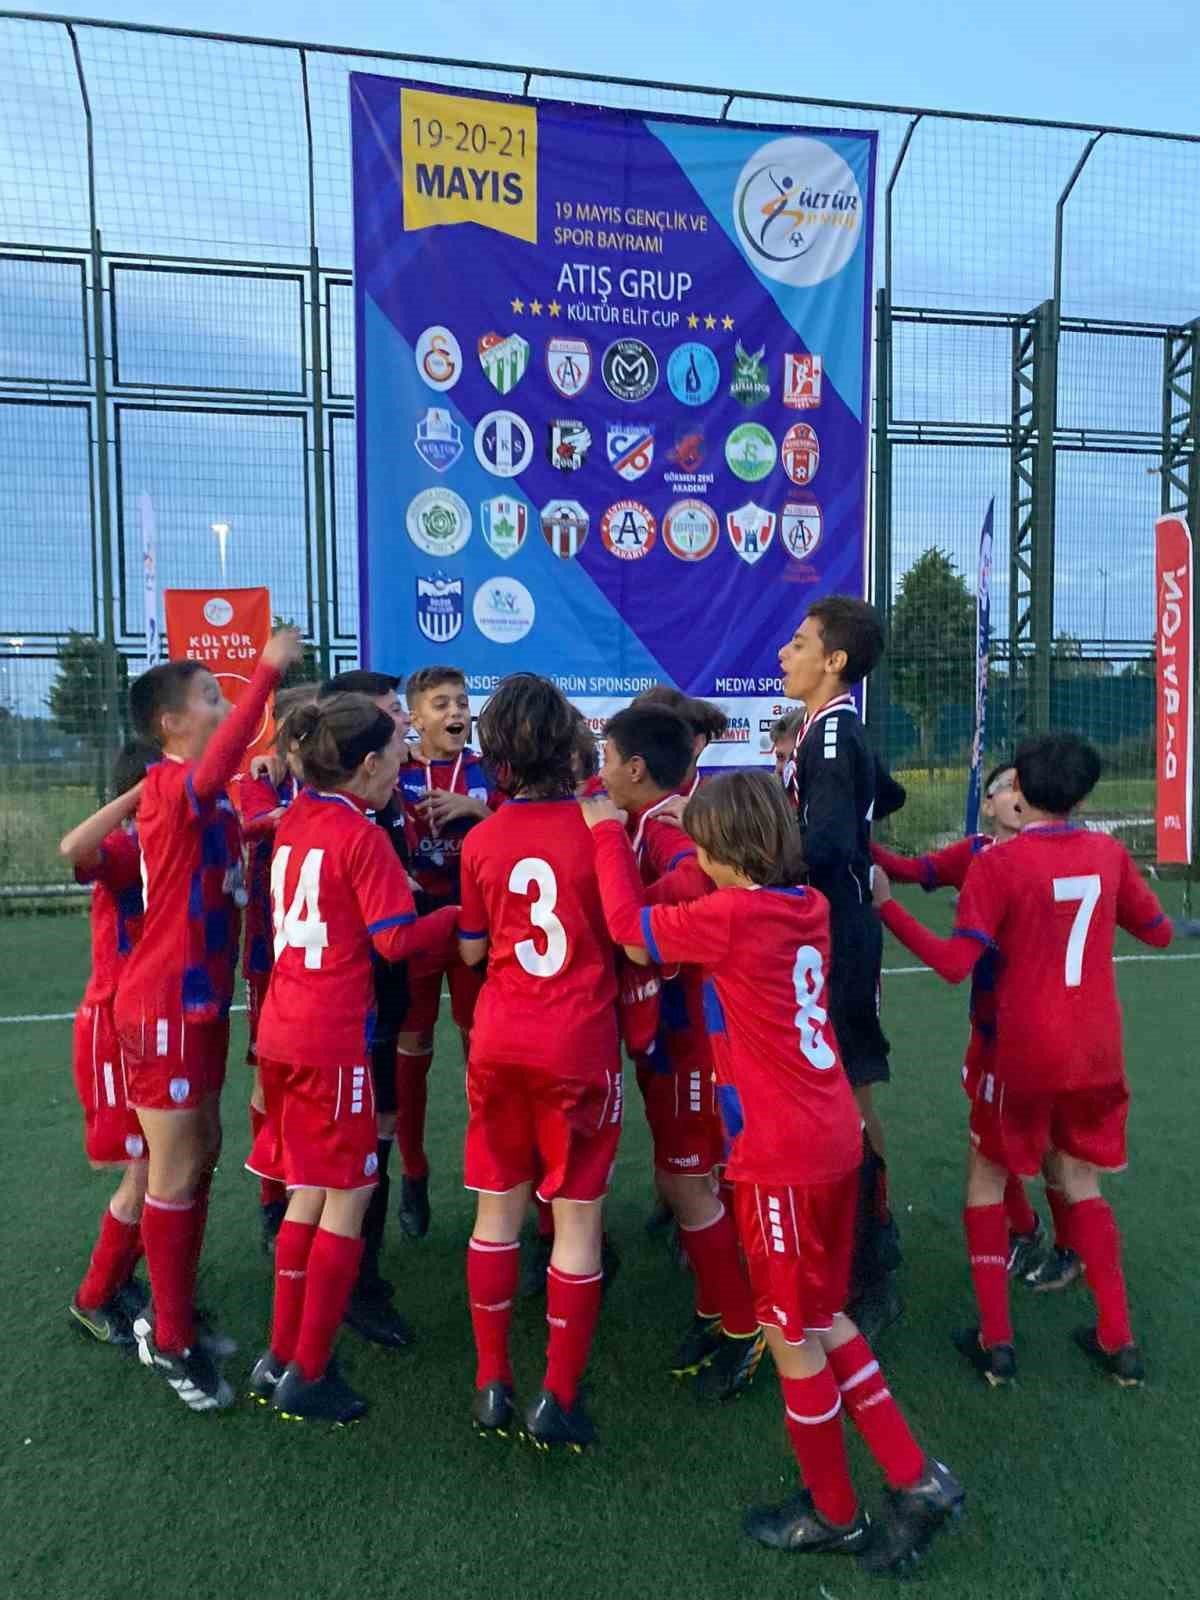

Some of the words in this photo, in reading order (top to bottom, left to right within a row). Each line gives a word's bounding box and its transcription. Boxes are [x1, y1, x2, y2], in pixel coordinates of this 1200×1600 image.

[412, 117, 526, 158] 19-20-21
[416, 163, 523, 205] MAYIS
[553, 221, 594, 248] SPOR
[597, 231, 663, 254] BAYRAMI
[555, 201, 573, 220] 19
[576, 203, 621, 225] MAYIS
[625, 208, 688, 232] GENÇLİK
[690, 214, 708, 233] VE
[556, 263, 613, 304] ATIŞ
[619, 268, 692, 302] GRUP
[567, 302, 619, 322] KÜLTÜR
[651, 310, 679, 328] CUP
[226, 647, 257, 660] CUP
[715, 677, 757, 692] MEDYA
[758, 678, 785, 692] SPO
[271, 845, 329, 970] 14
[509, 857, 567, 977] 3
[1053, 874, 1102, 987] 7
[792, 944, 836, 1069] 8
